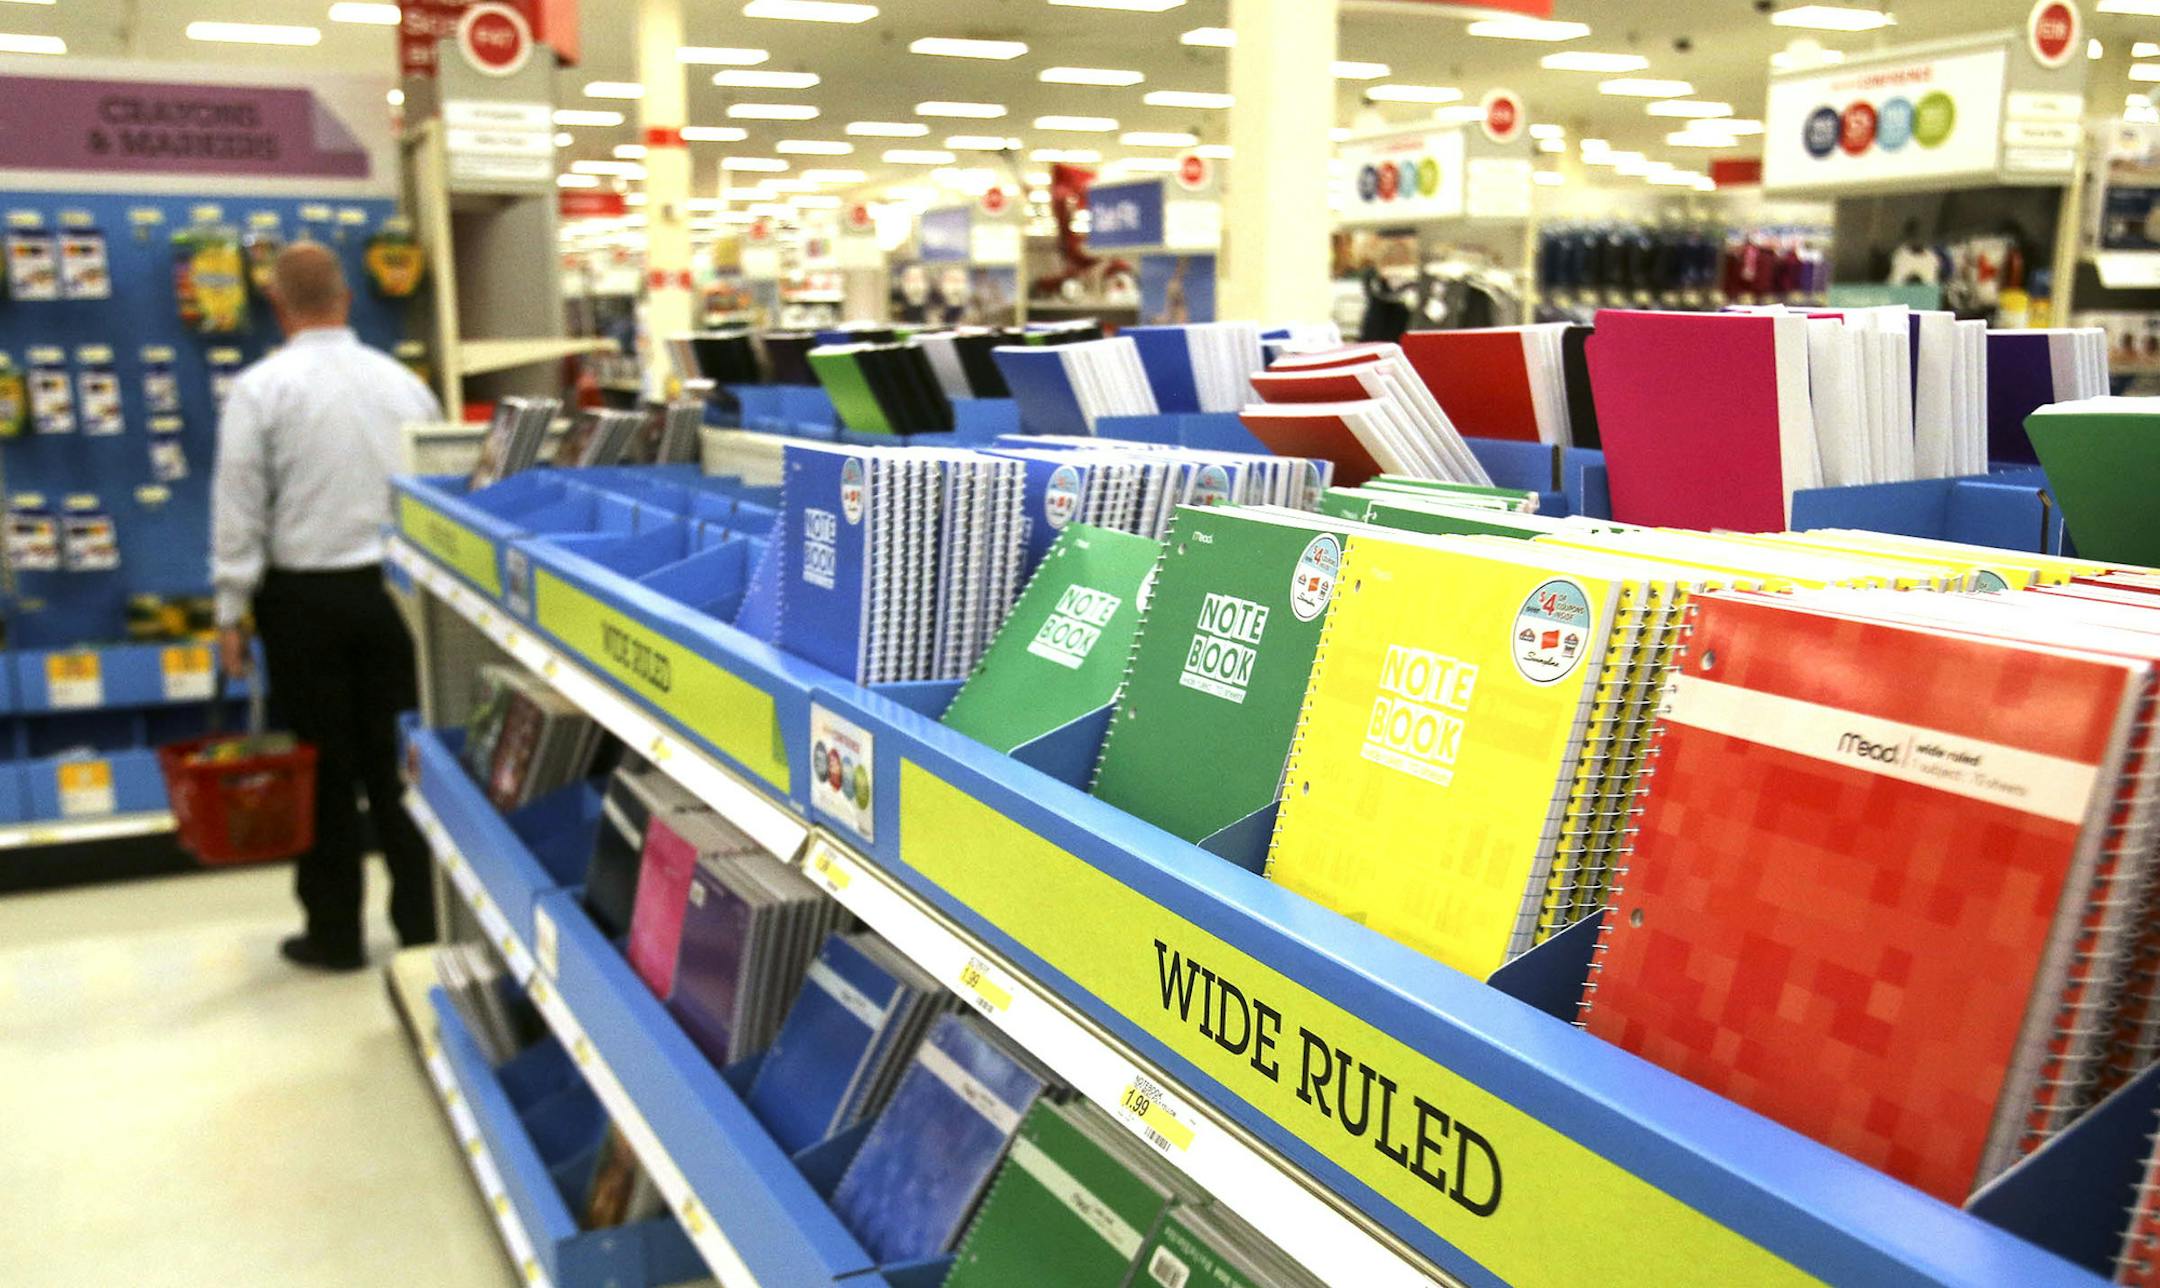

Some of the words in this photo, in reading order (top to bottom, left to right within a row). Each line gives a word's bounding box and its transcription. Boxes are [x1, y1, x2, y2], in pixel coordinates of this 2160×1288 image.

[101, 96, 260, 126] CRAYONS
[119, 130, 280, 159] MARKERS
[1057, 585, 1120, 626] NOTE
[1198, 594, 1269, 643] NOTE
[1036, 615, 1100, 656] BOOK
[1186, 635, 1256, 685] BOOK
[1381, 646, 1476, 709] NOTE
[1368, 699, 1462, 763] BOOK
[1154, 938, 1282, 1083] WIDE
[1296, 1026, 1503, 1218] RULED
[1125, 1088, 1151, 1117] 1.99
